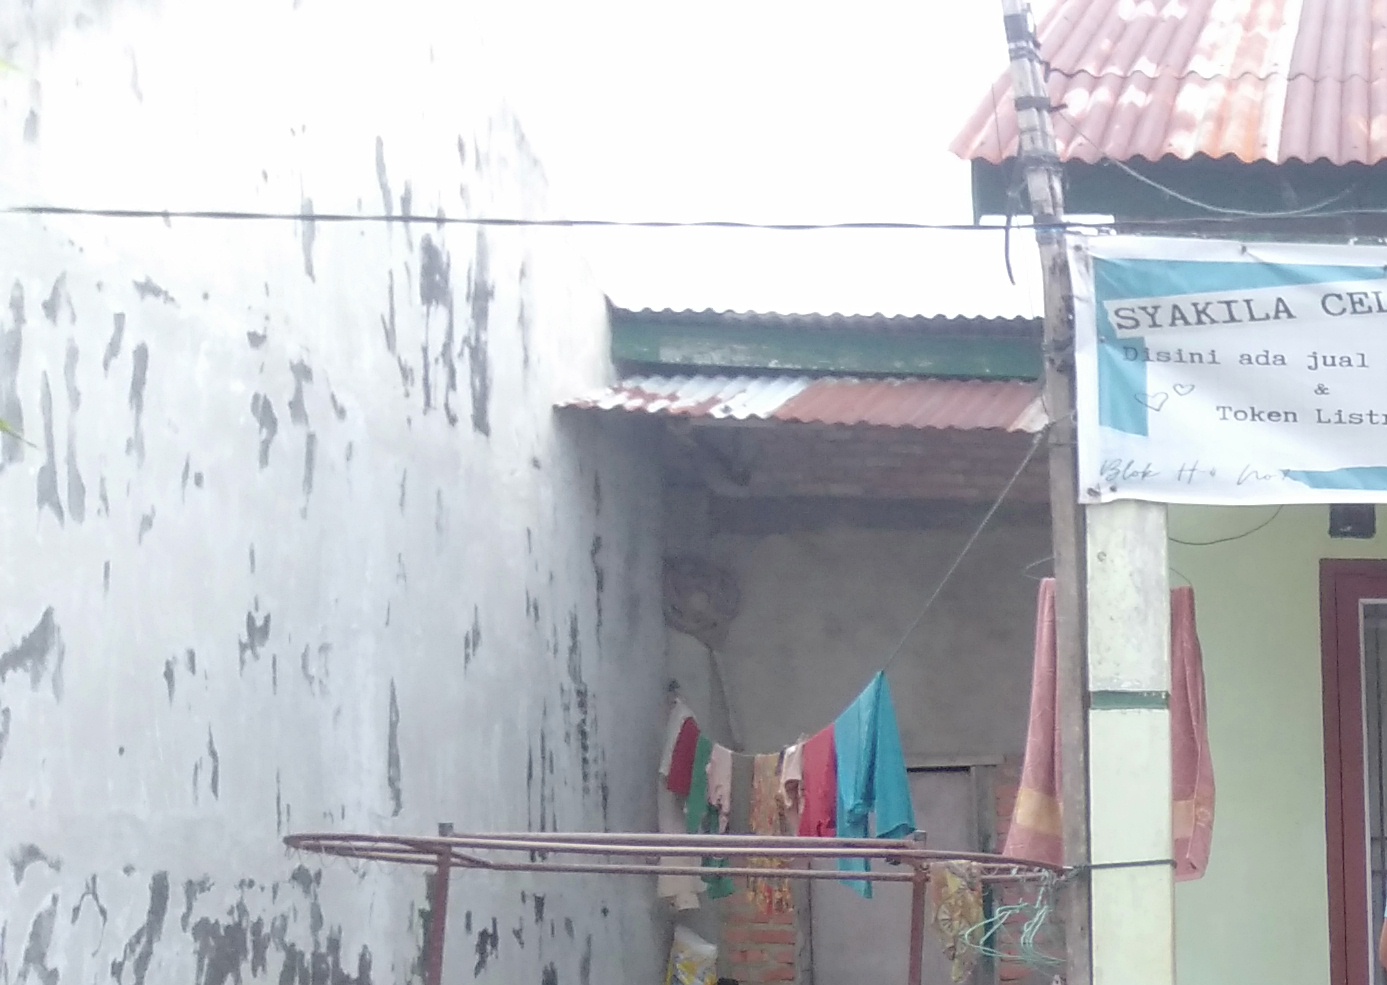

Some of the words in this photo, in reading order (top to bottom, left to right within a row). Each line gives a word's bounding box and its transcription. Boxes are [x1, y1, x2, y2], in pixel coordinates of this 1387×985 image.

[1114, 296, 1297, 331] SYAKILA
[1122, 345, 1222, 366] Disini
[1238, 349, 1288, 367] ada
[1306, 351, 1370, 372] jual
[1313, 382, 1330, 396] &
[1216, 405, 1299, 424] Token
[1099, 458, 1161, 482] Blok
